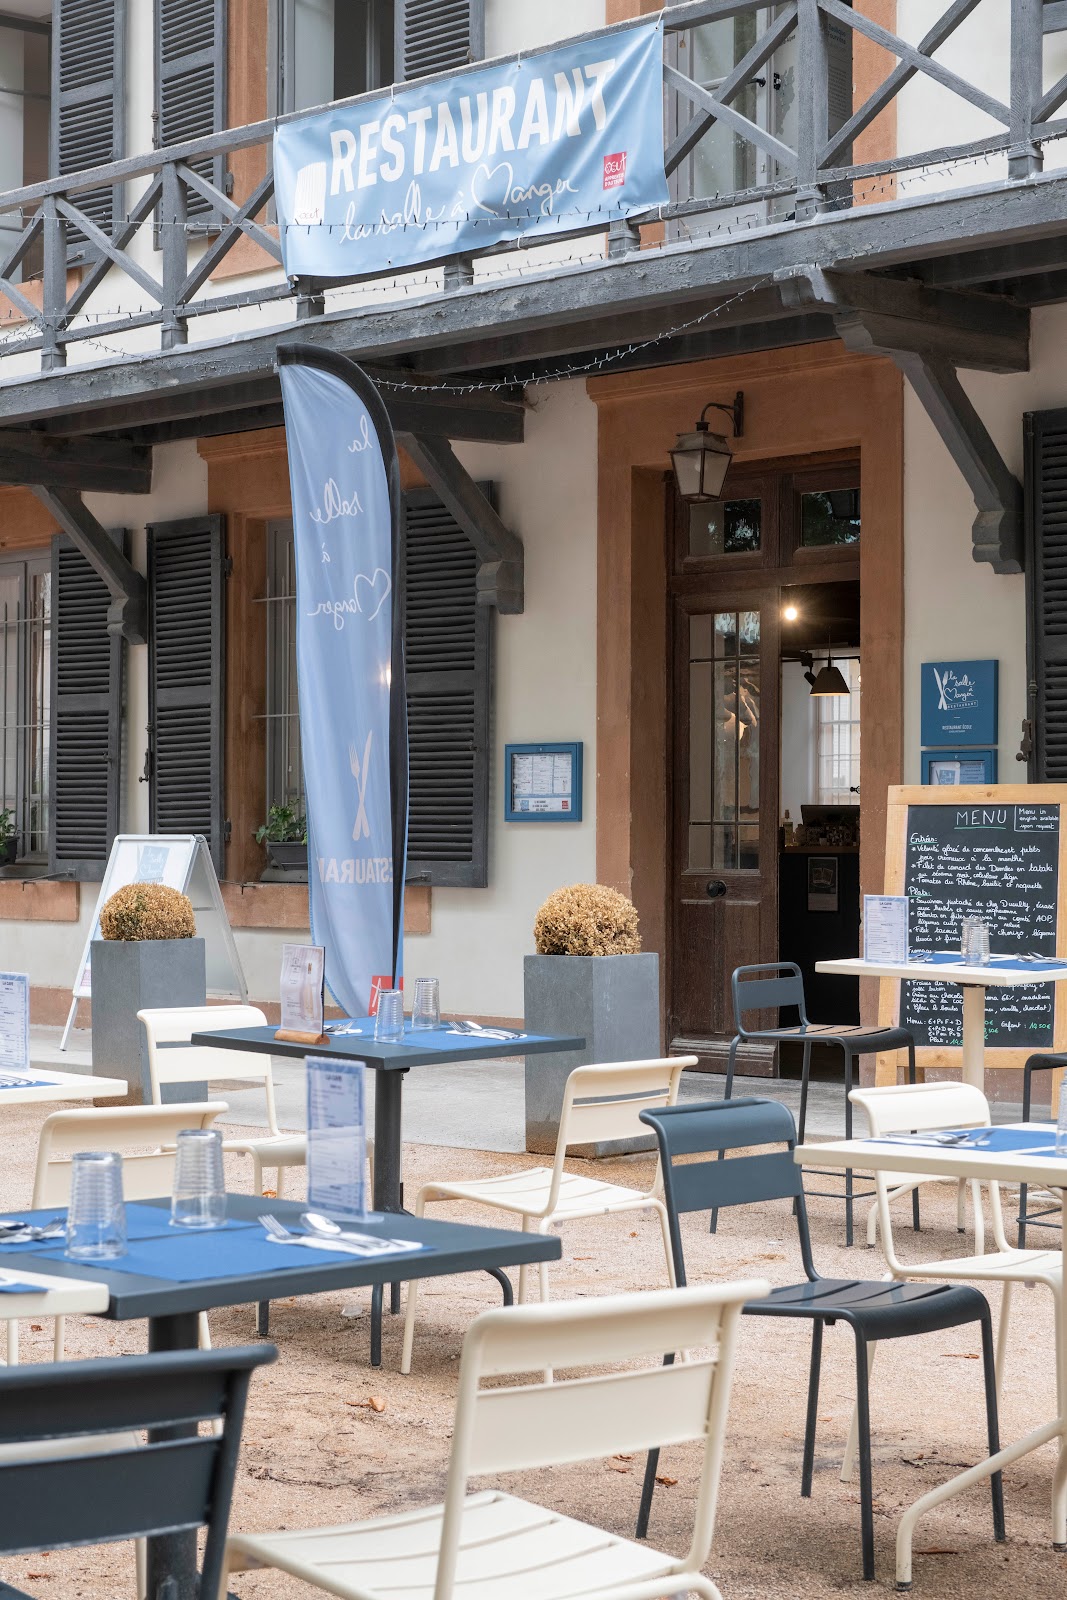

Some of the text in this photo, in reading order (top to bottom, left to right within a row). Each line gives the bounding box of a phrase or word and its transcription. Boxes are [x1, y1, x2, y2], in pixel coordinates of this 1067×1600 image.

[330, 58, 616, 196] RESTAURANT
[339, 202, 369, 244] la
[375, 180, 445, 235] salle
[450, 197, 465, 215] à
[956, 810, 1007, 825] MENU
[942, 844, 959, 856] glacé
[1020, 845, 1041, 856] petits
[998, 855, 1024, 863] menthe
[916, 861, 935, 870] Filet
[947, 863, 972, 871] canard
[1029, 863, 1053, 872] tataki
[916, 877, 941, 885] Tomates
[916, 910, 939, 919] Polenta
[913, 926, 929, 934] Filet
